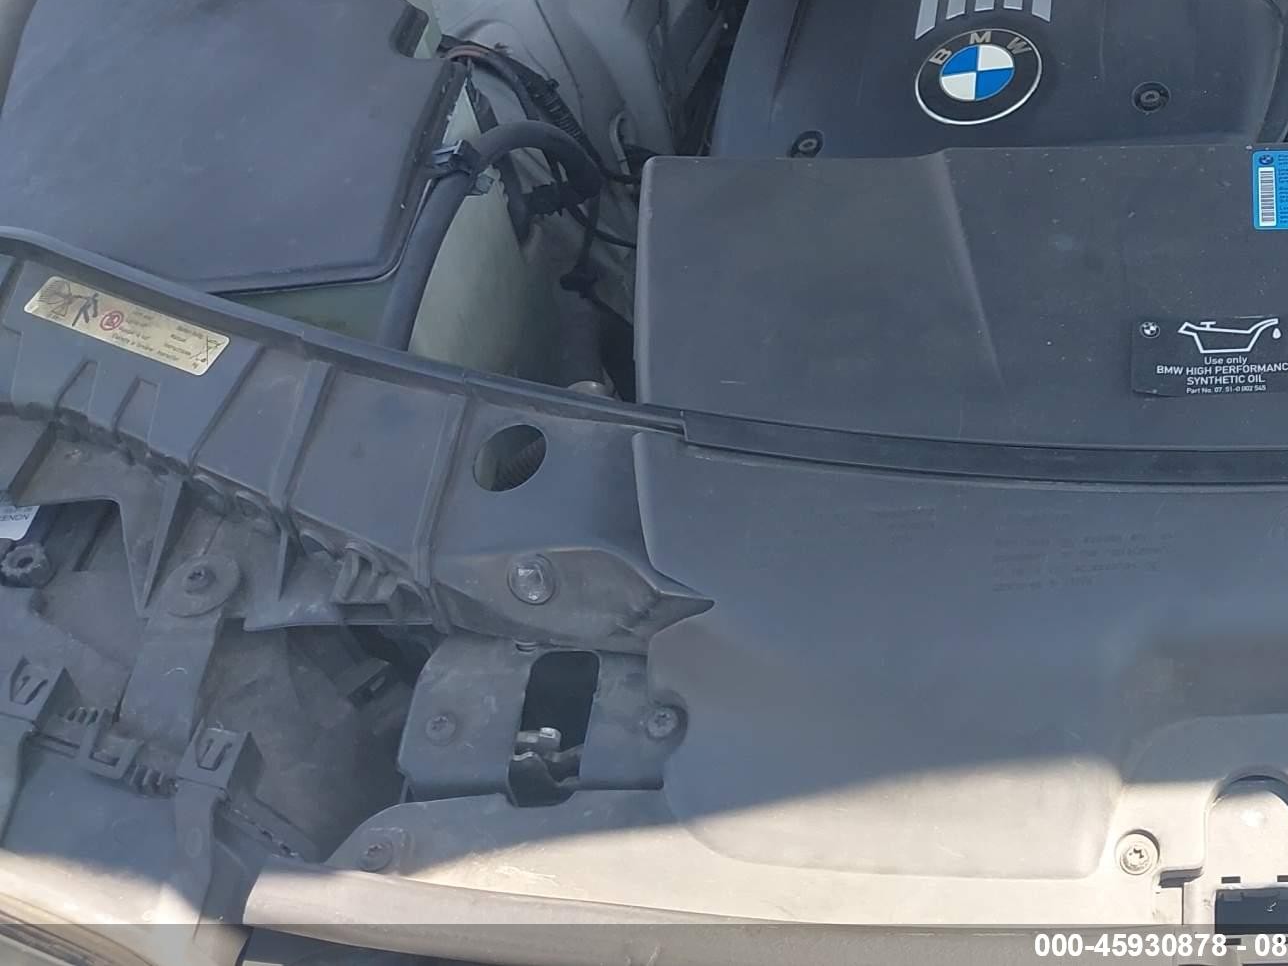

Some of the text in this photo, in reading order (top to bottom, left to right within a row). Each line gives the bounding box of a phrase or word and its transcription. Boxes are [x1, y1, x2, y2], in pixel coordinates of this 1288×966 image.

[929, 31, 1032, 65] BMW
[1204, 355, 1248, 366] Use only
[1156, 365, 1183, 375] BMW
[1186, 365, 1212, 376] HIGH
[1186, 374, 1266, 386] SYNTHETIC OIL
